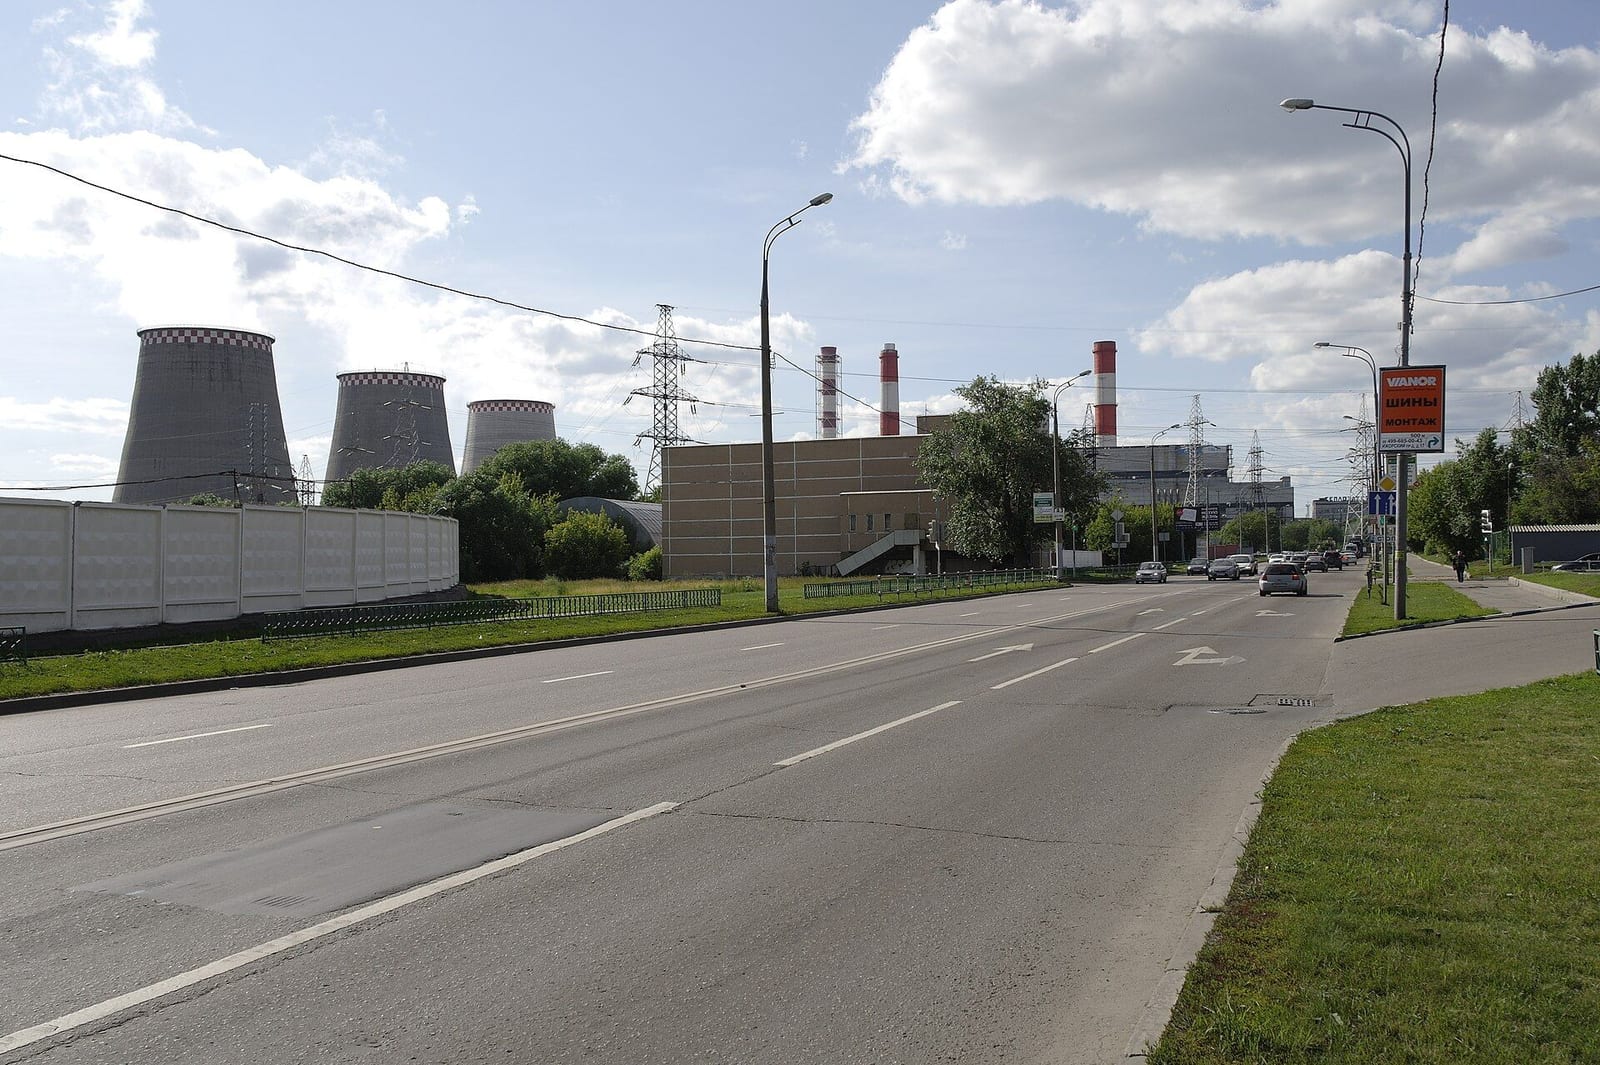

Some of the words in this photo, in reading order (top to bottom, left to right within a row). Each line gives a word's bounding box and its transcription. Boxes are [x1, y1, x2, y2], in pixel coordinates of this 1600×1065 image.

[1386, 376, 1437, 387] VIANOR
[1386, 397, 1437, 407] ШИНЫ
[1386, 417, 1437, 426] МОНТАЖ
